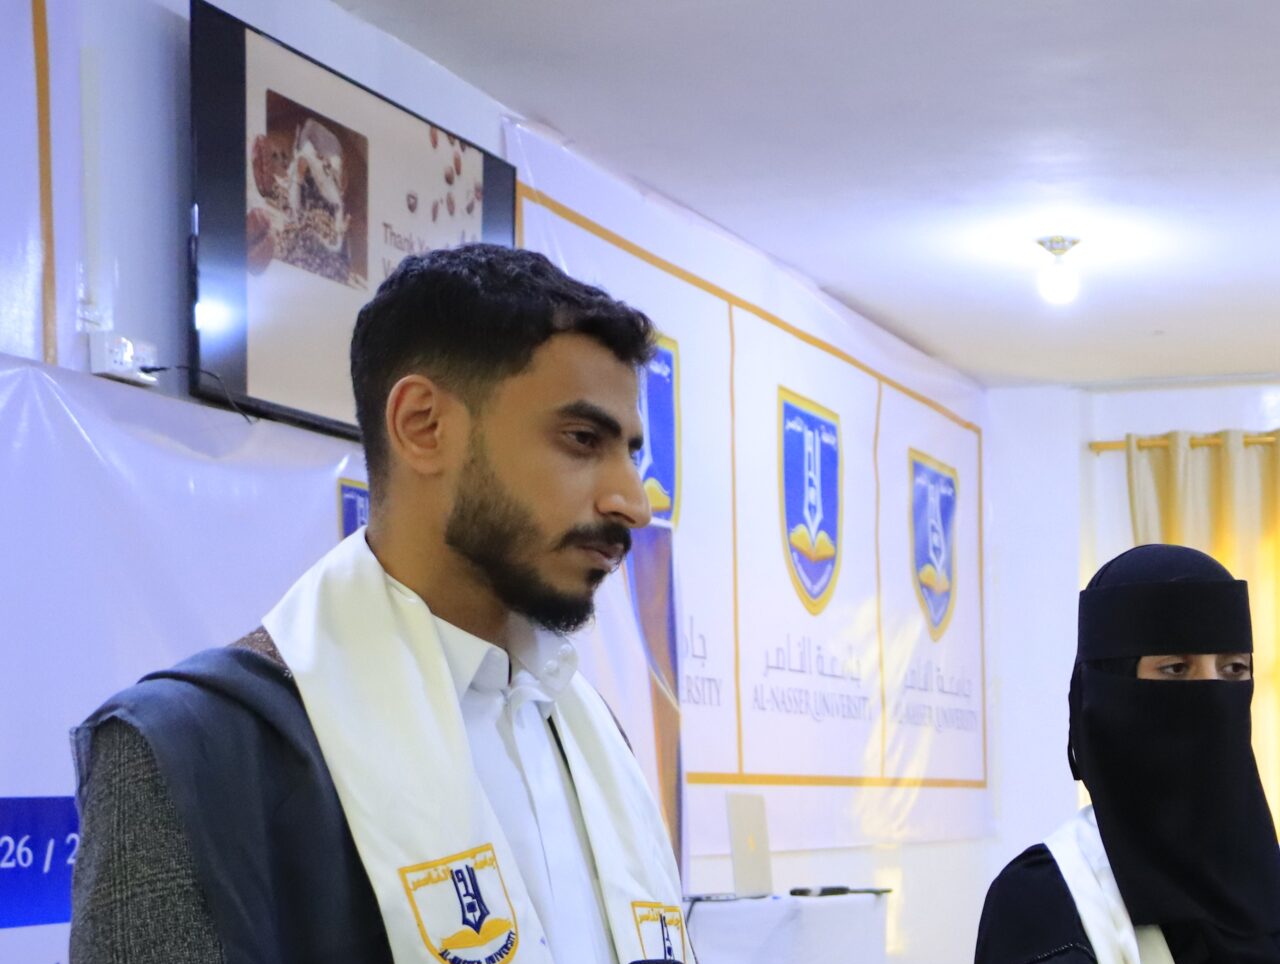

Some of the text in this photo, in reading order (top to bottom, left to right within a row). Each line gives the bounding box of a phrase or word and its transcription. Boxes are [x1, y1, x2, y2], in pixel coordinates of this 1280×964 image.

[682, 674, 722, 707] RSITY
[752, 683, 815, 719] AL-NASSER
[0, 836, 33, 868] 26
